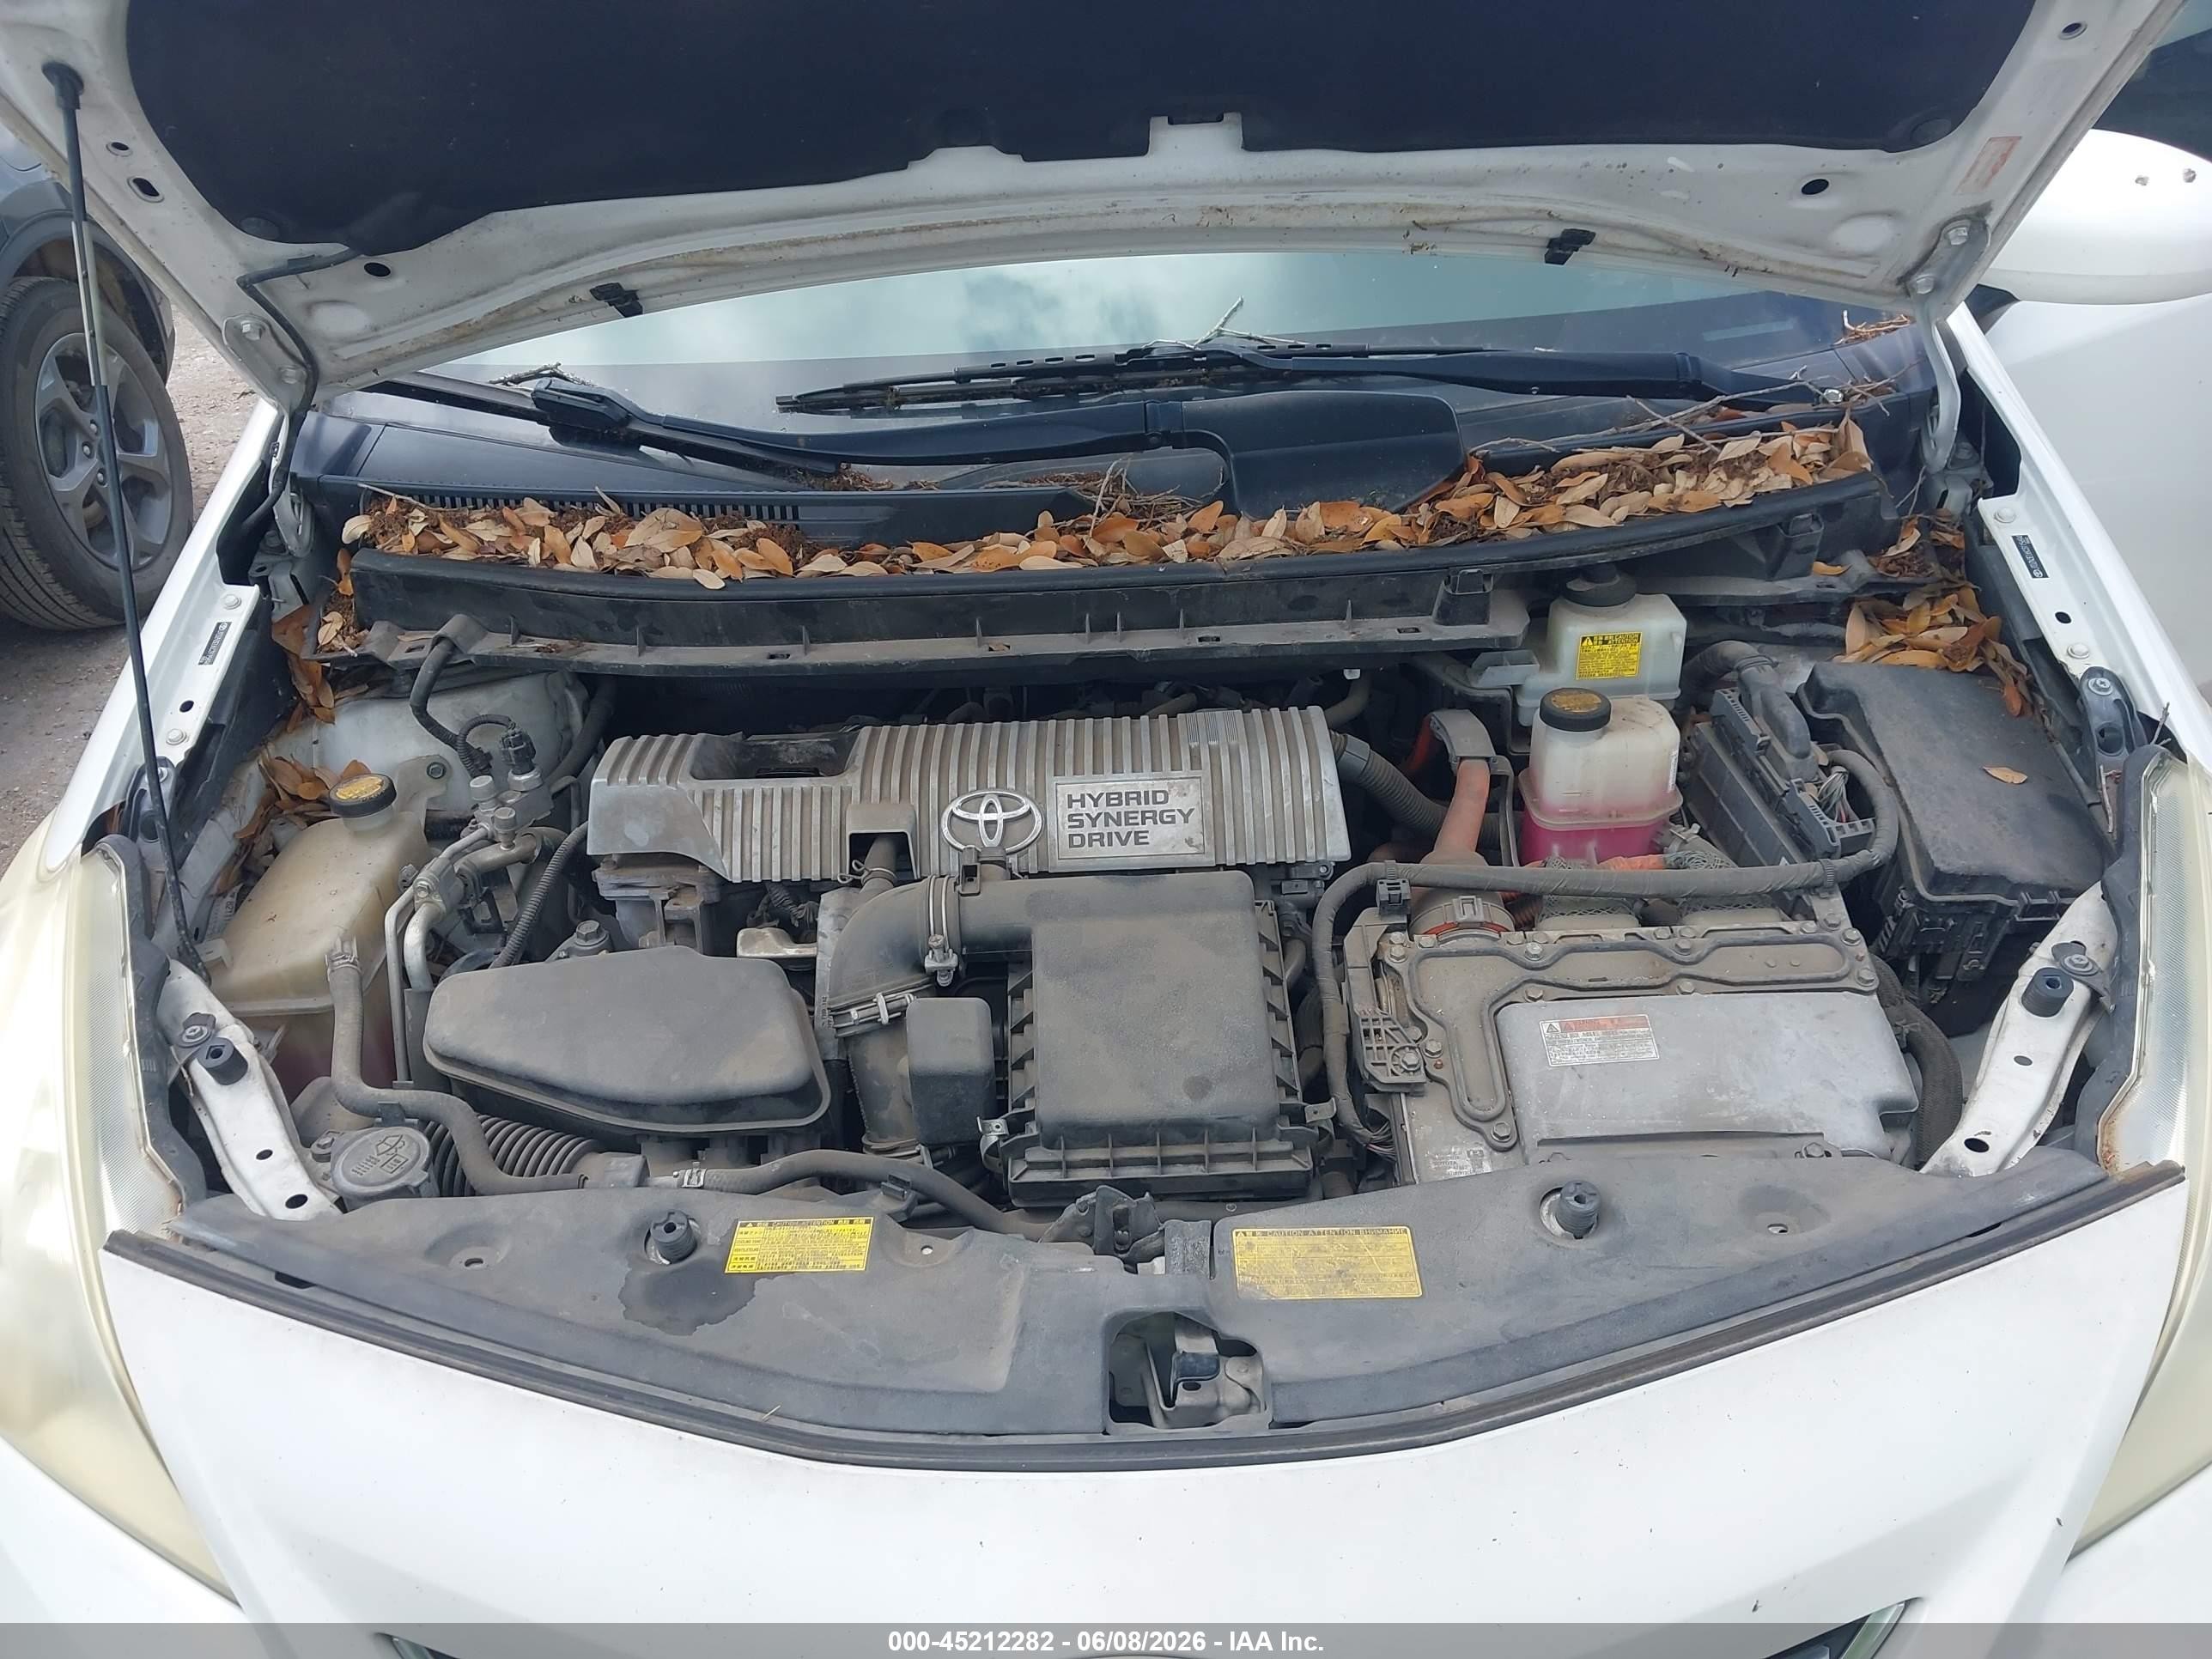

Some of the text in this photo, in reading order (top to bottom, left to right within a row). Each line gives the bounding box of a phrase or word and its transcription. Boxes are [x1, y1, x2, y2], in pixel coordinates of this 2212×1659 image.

[1067, 790, 1169, 809] HYBRID
[1067, 808, 1195, 829] SYNERGY
[1068, 830, 1150, 848] DRIVE
